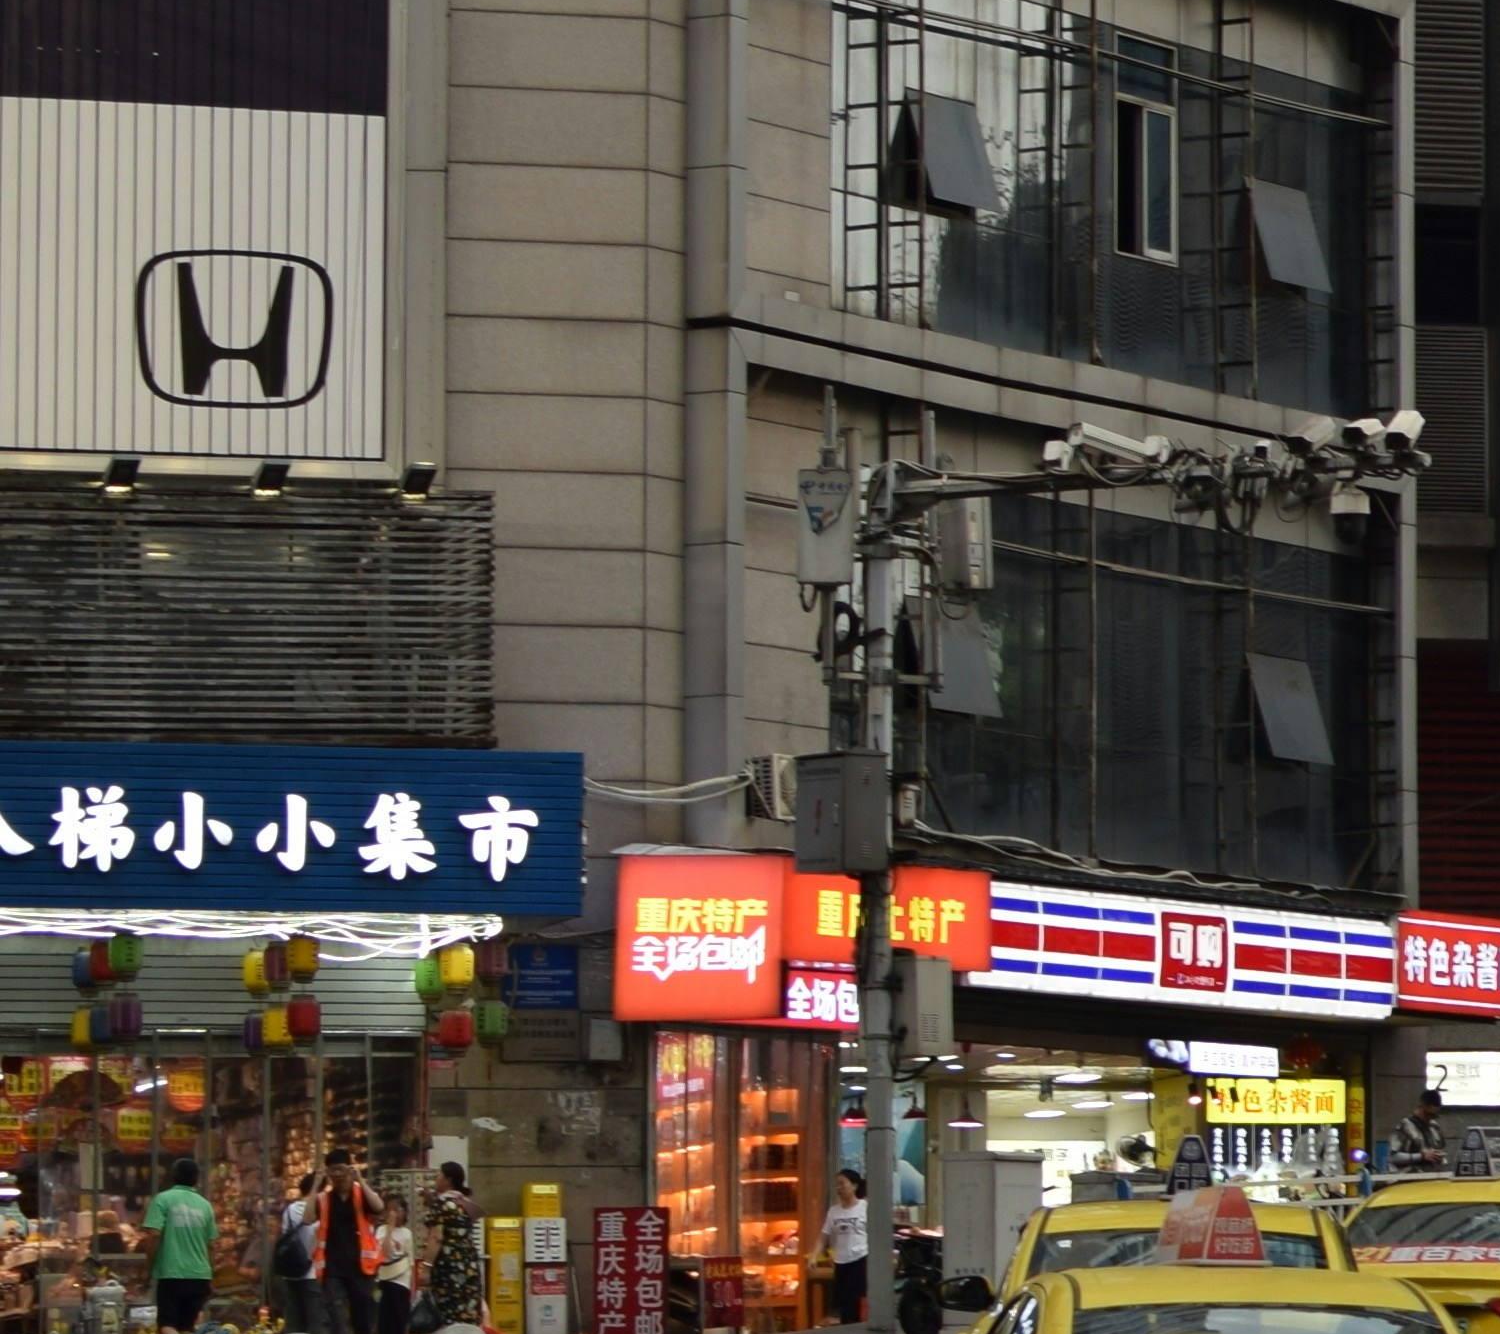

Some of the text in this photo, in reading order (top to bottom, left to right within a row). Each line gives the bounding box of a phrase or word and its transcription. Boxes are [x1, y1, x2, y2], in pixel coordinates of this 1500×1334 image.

[636, 897, 768, 934] 重庆特产
[632, 925, 766, 985] 全场包邮
[1434, 1064, 1449, 1093] 2
